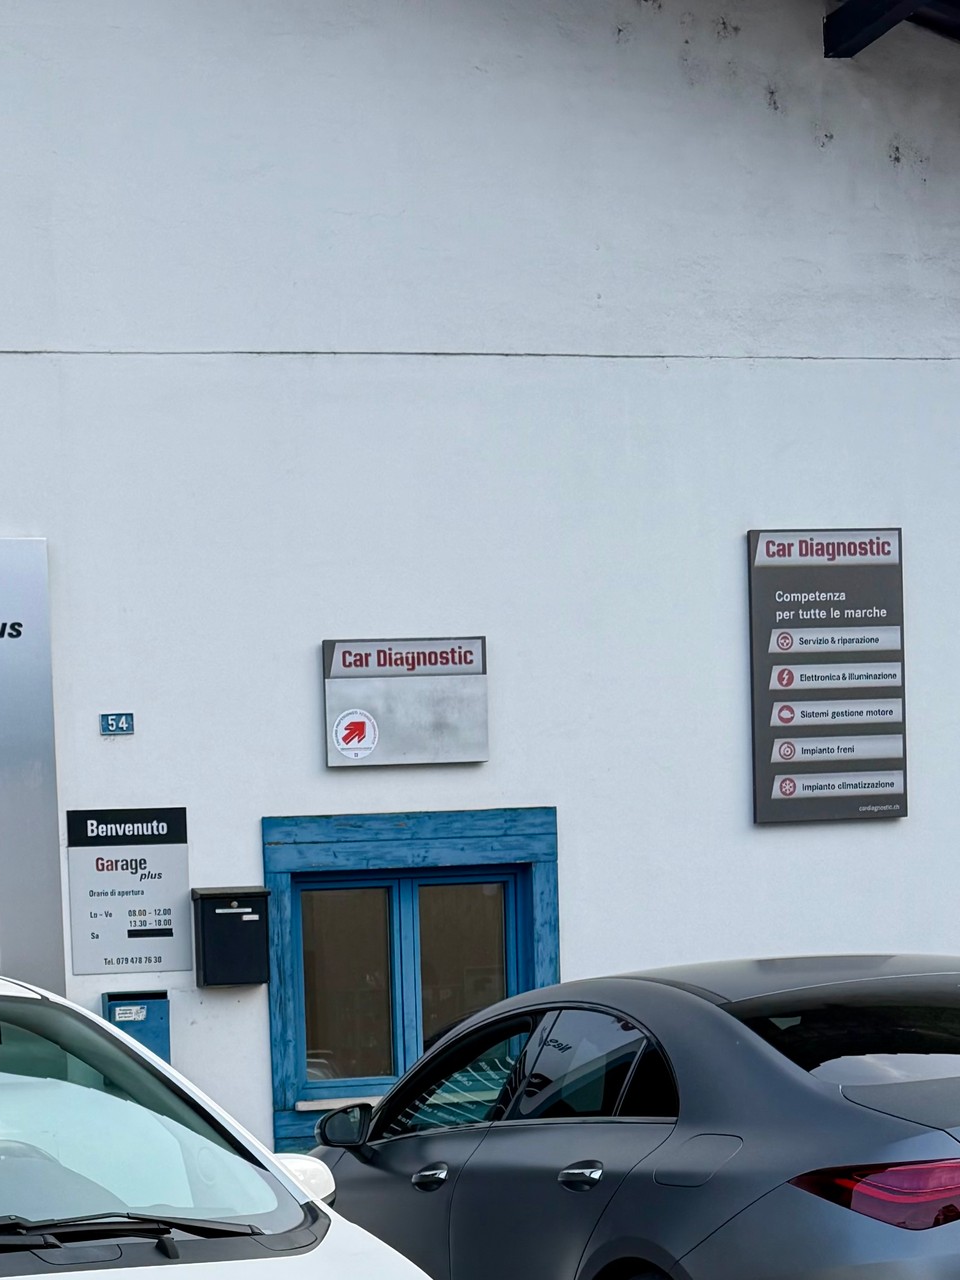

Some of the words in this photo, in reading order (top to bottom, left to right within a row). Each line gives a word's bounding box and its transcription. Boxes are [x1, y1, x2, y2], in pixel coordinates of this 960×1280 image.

[765, 540, 794, 558] Car
[799, 537, 891, 561] Diagnostic
[775, 591, 846, 604] Competenza
[776, 610, 795, 622] per
[799, 608, 826, 619] tutte
[830, 607, 840, 618] le
[845, 606, 887, 618] marche
[799, 636, 829, 645] Servizio
[831, 637, 836, 645] &
[837, 636, 879, 646] riparazione
[342, 650, 371, 668] Car
[376, 646, 474, 671] Diagnostic
[799, 673, 841, 682] Elettronica
[842, 673, 847, 681] &
[848, 672, 897, 681] illuminazione
[800, 710, 829, 719] Sistemi
[831, 709, 864, 719] gestione
[866, 708, 893, 717] motore
[108, 716, 128, 730] 54
[801, 746, 835, 756] Impianto
[837, 745, 855, 754] freni
[802, 783, 835, 792] Impianto
[837, 781, 895, 790] climatizzazione
[86, 820, 168, 837] Benvenuto
[96, 857, 147, 874] Garage
[139, 871, 163, 881] plus
[117, 889, 144, 897] apertura
[154, 908, 171, 916] 12.00
